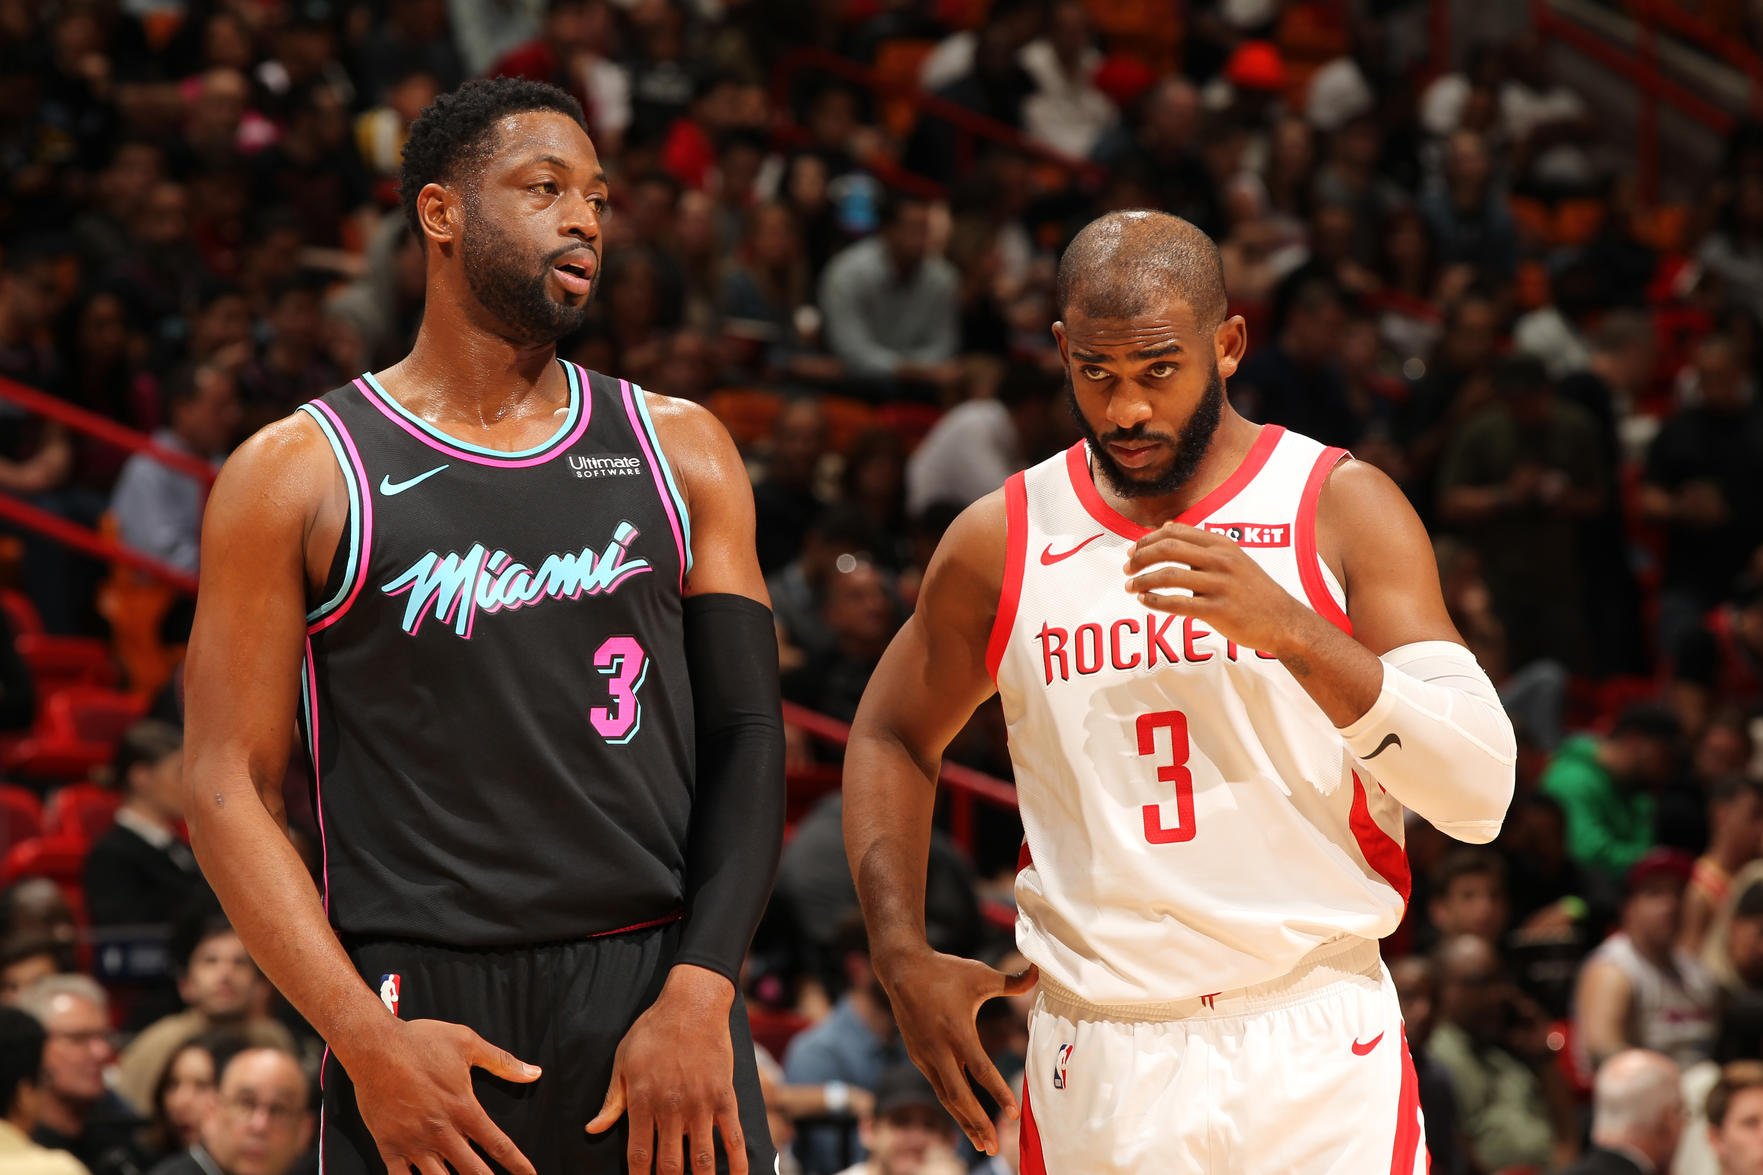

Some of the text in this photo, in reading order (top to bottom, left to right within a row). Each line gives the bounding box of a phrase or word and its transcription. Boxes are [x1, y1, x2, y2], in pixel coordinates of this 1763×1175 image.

[568, 456, 641, 470] Ultimate
[576, 467, 641, 478] SOFTWARE
[381, 520, 653, 640] Miami
[589, 635, 650, 745] 3
[1034, 613, 1280, 686] ROCKE
[1136, 710, 1197, 844] 3
